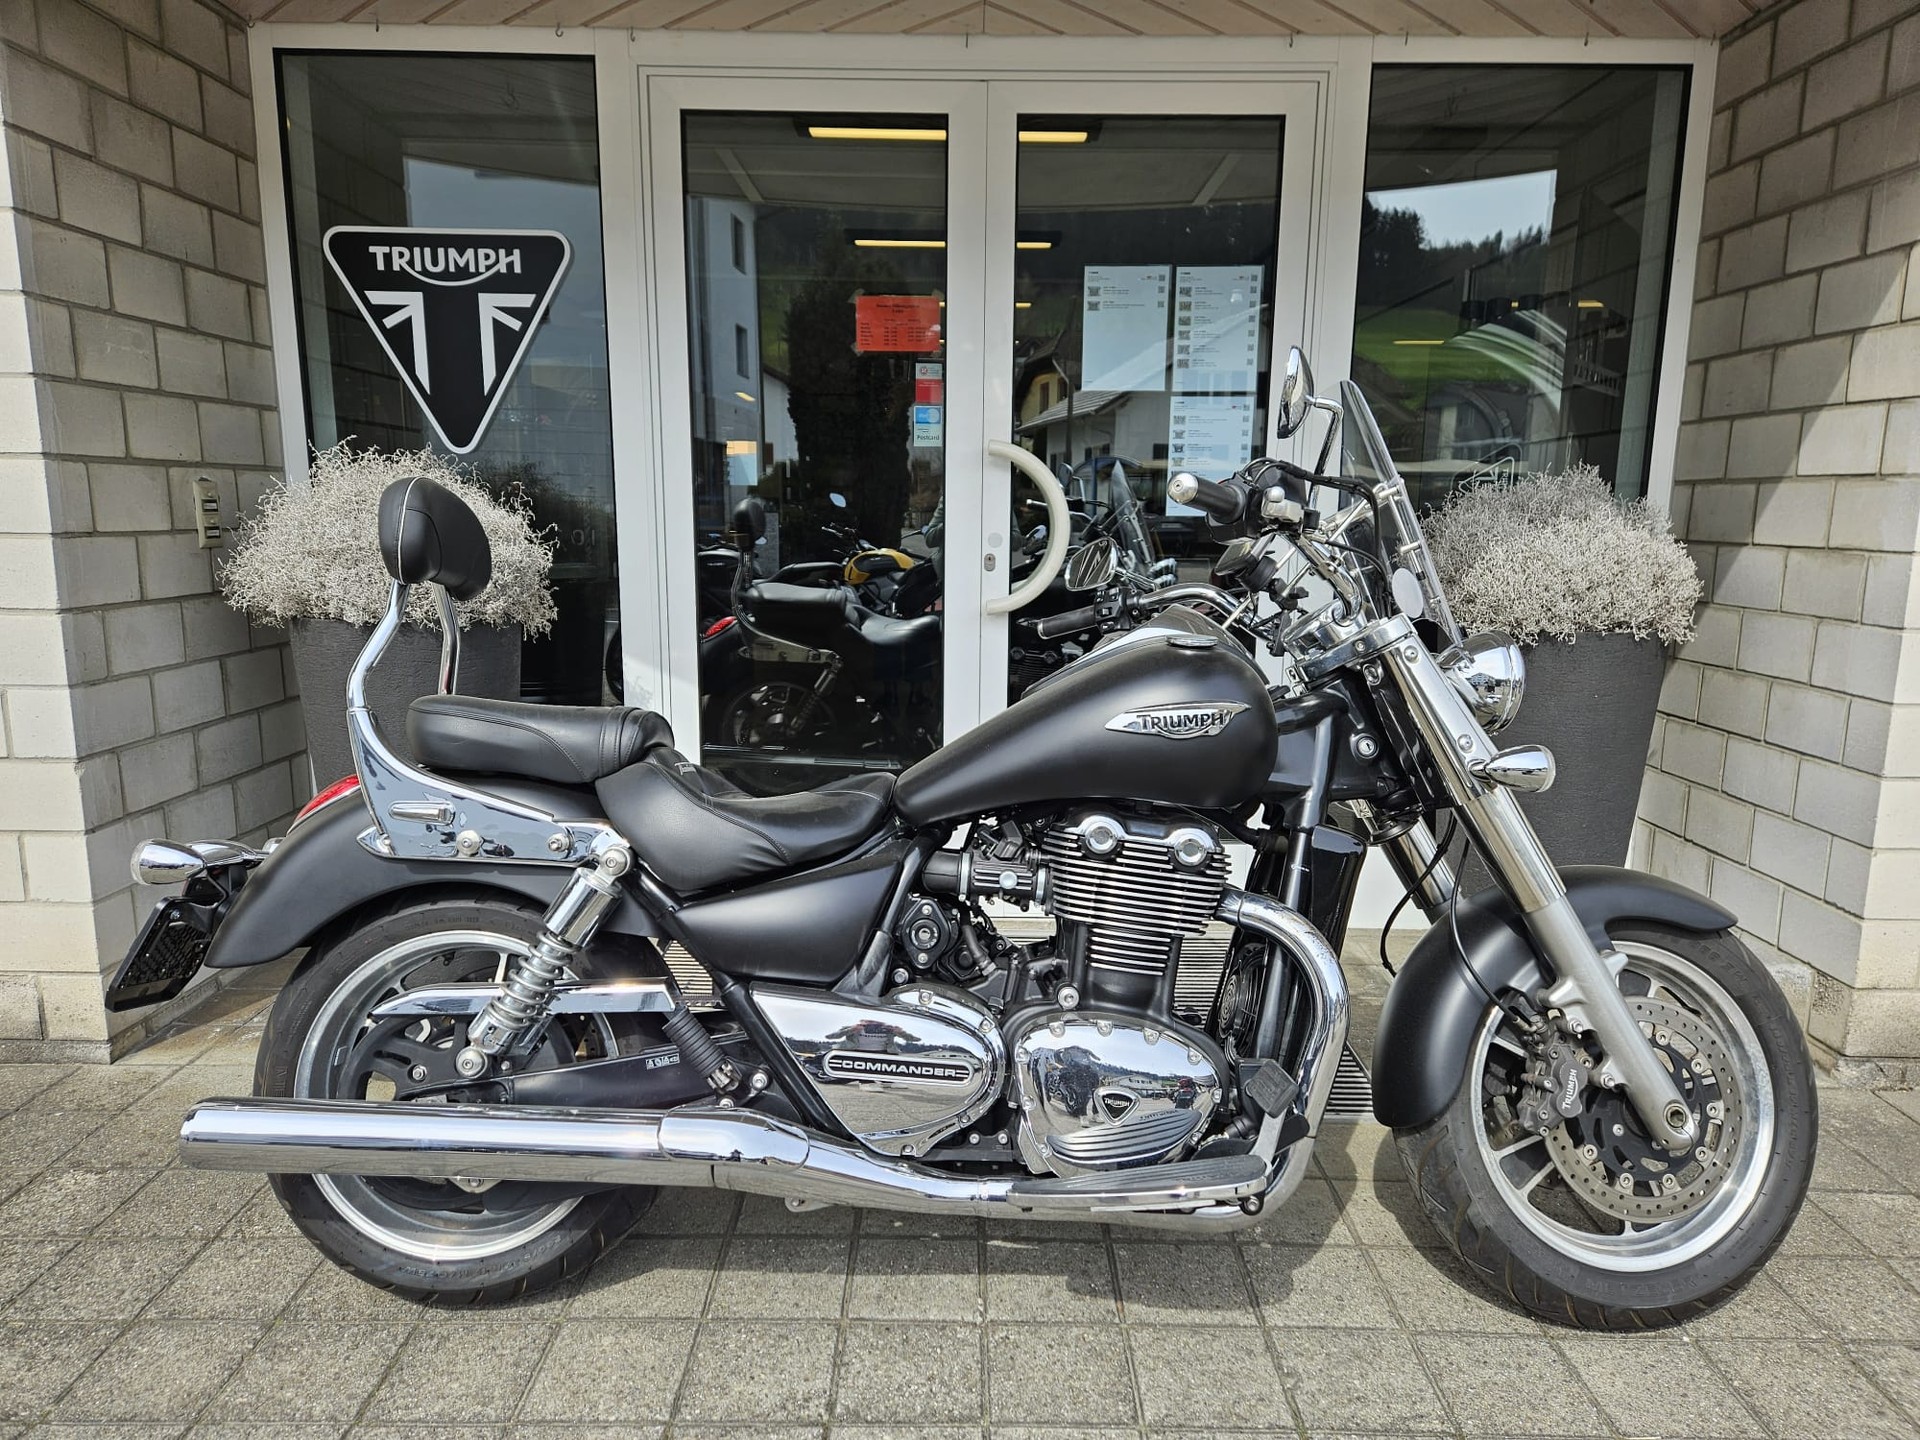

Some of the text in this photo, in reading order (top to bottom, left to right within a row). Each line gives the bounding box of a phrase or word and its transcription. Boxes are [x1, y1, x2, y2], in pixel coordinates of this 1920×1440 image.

[368, 245, 522, 286] TRIUMPH
[1136, 711, 1227, 735] TRIUMPH
[841, 1059, 956, 1077] COMMANDER
[1562, 1068, 1578, 1109] TRIUMPH
